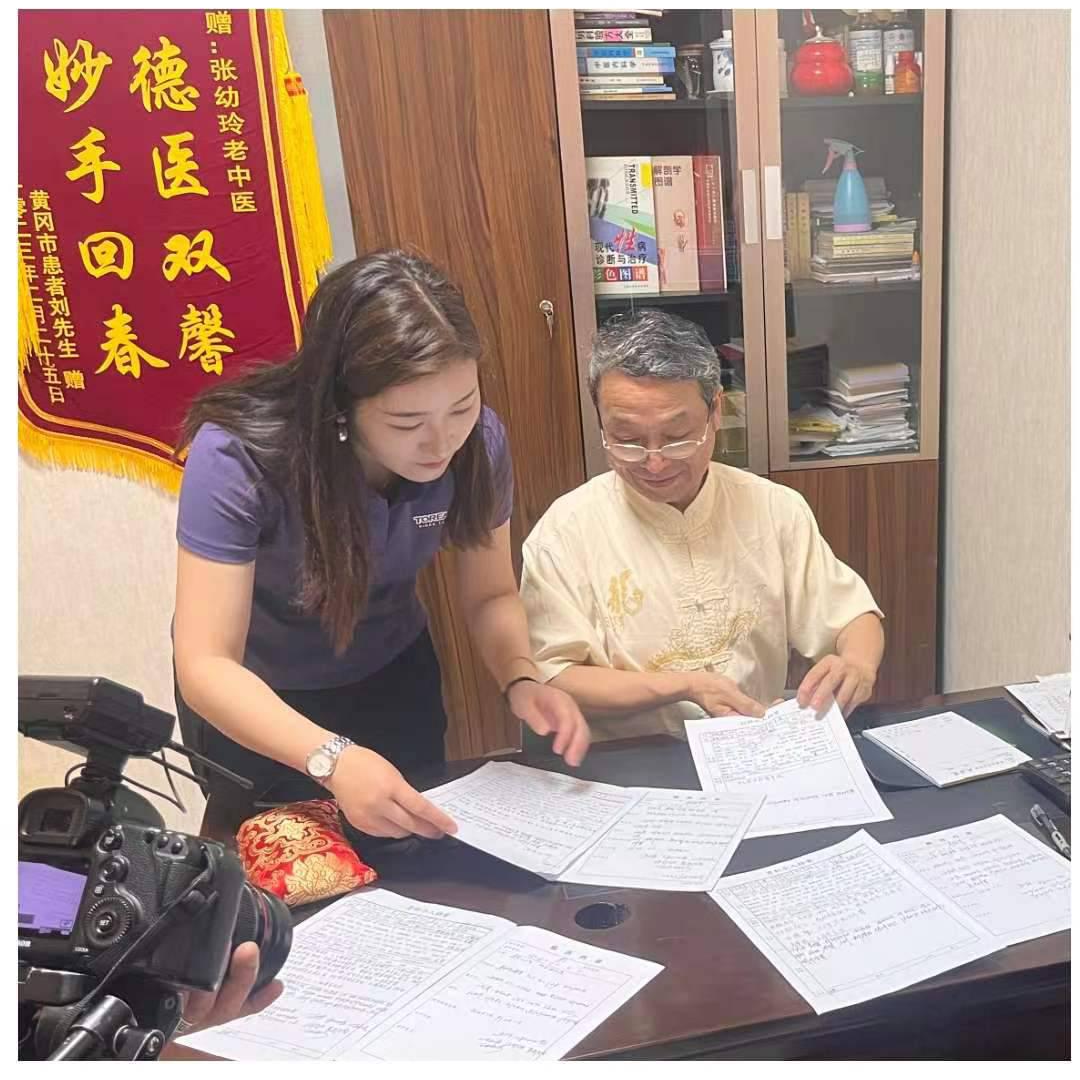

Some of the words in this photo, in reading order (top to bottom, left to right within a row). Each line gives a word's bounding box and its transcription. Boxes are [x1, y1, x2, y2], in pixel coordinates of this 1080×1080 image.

[44, 38, 171, 379] 妙手回春
[129, 36, 236, 376] 德医双馨
[596, 254, 648, 265] 诊断与治疗
[628, 164, 639, 214] TRANSMITTED
